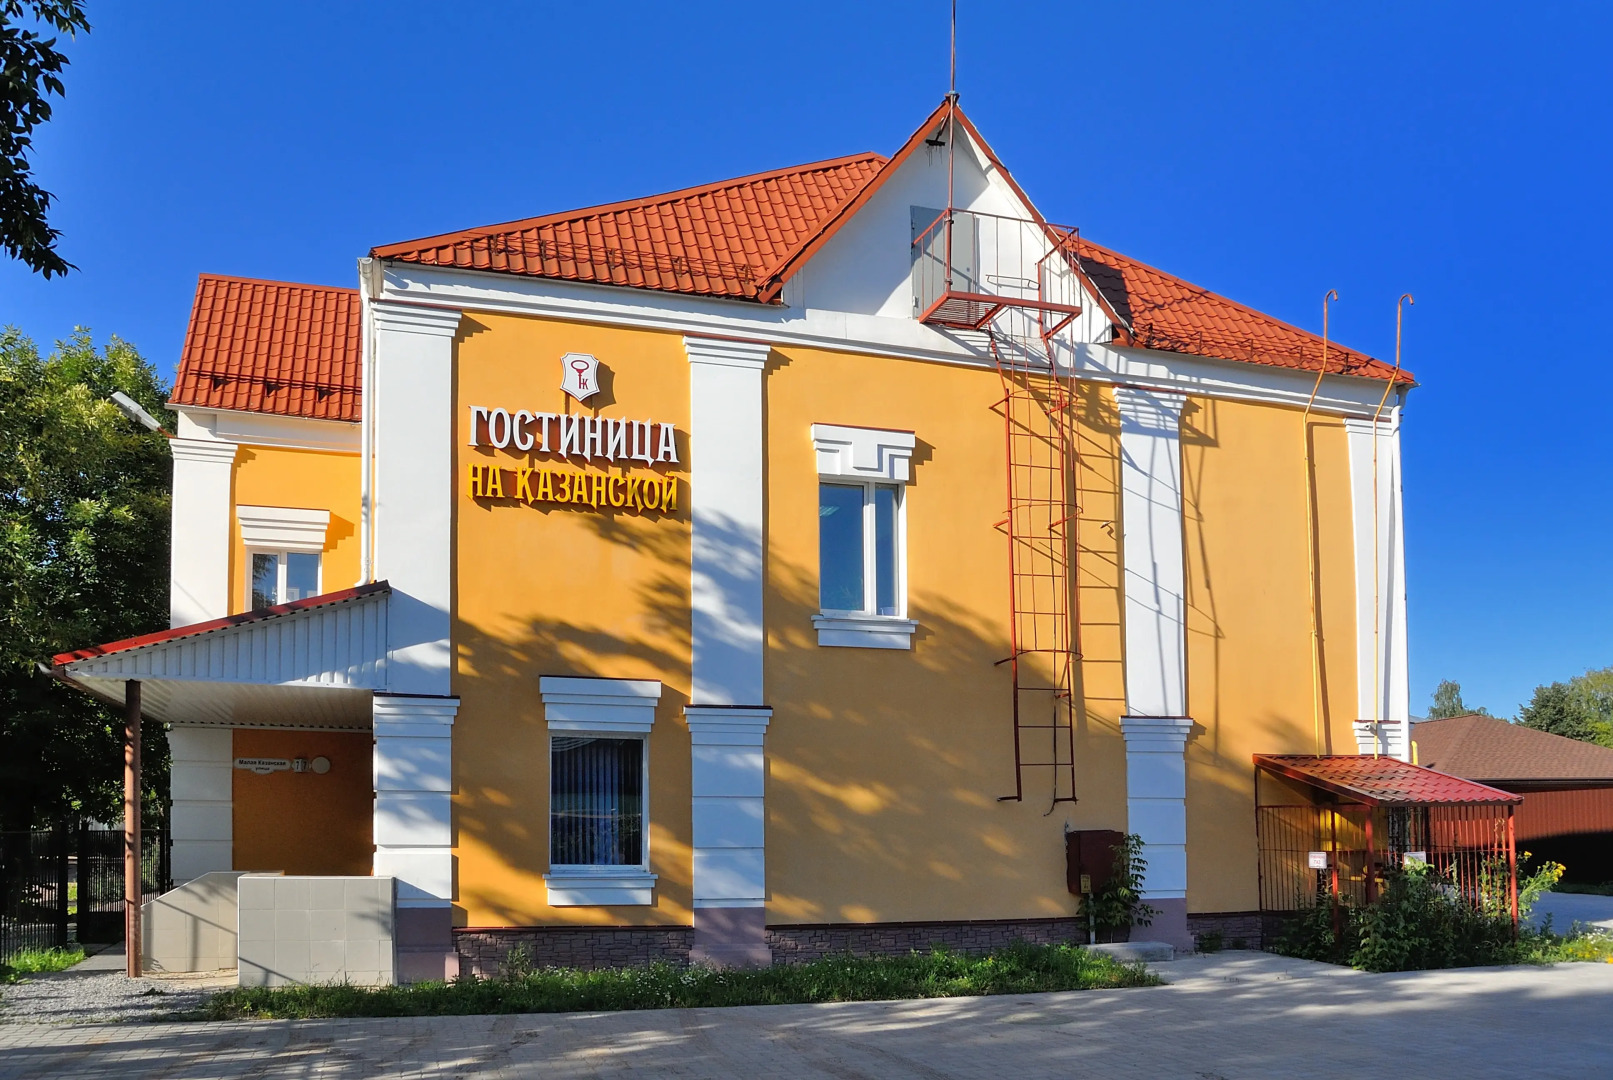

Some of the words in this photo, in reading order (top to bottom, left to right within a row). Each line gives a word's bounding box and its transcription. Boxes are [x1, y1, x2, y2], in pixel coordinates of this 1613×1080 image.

[467, 405, 680, 467] ГОСТИНИЦА
[467, 463, 505, 500] НА
[514, 465, 678, 513] КАЗАНСКОЙ
